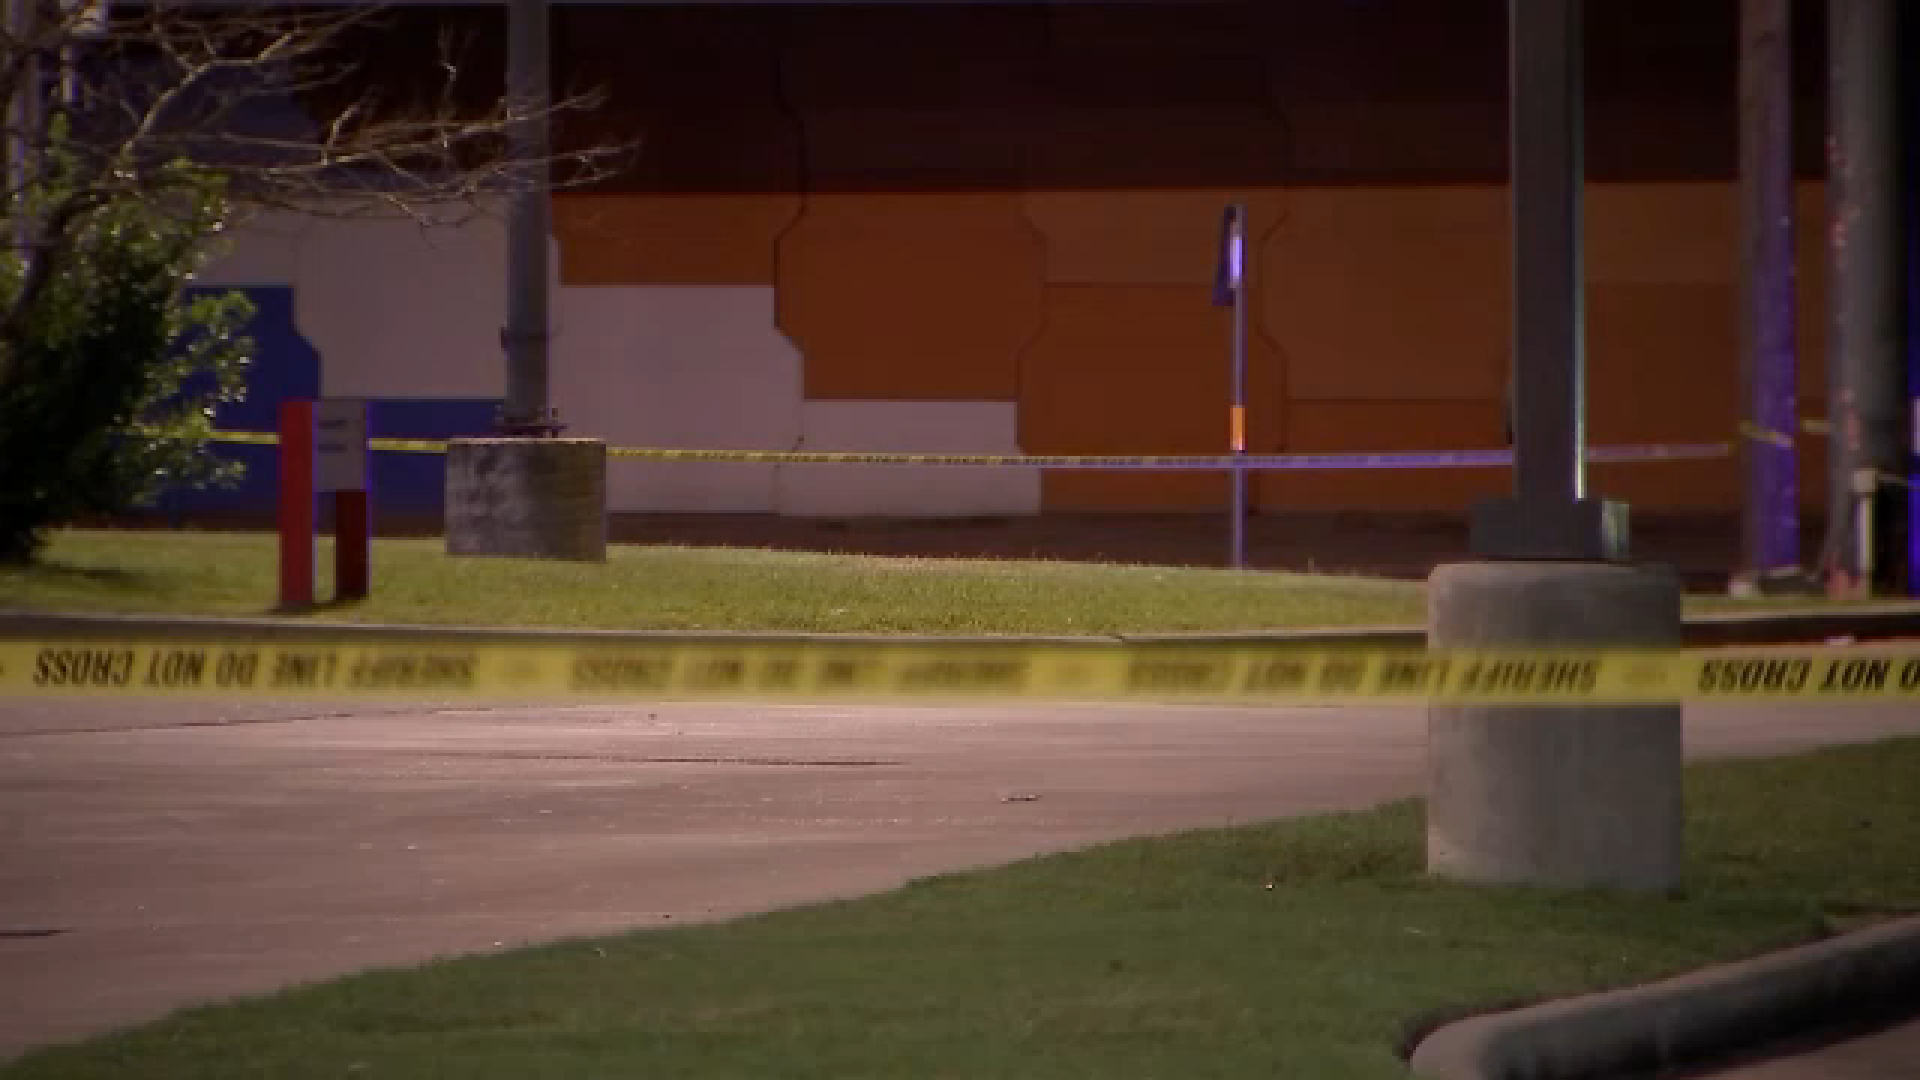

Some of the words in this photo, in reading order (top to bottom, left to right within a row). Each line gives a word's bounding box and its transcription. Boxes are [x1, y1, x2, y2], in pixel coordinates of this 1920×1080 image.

[32, 647, 135, 686] CROSS
[144, 648, 206, 687] NOT
[215, 649, 259, 688] DO
[1457, 656, 1601, 693] SHERIFF
[1697, 656, 1812, 692] CROSS
[1817, 656, 1890, 692] NOT
